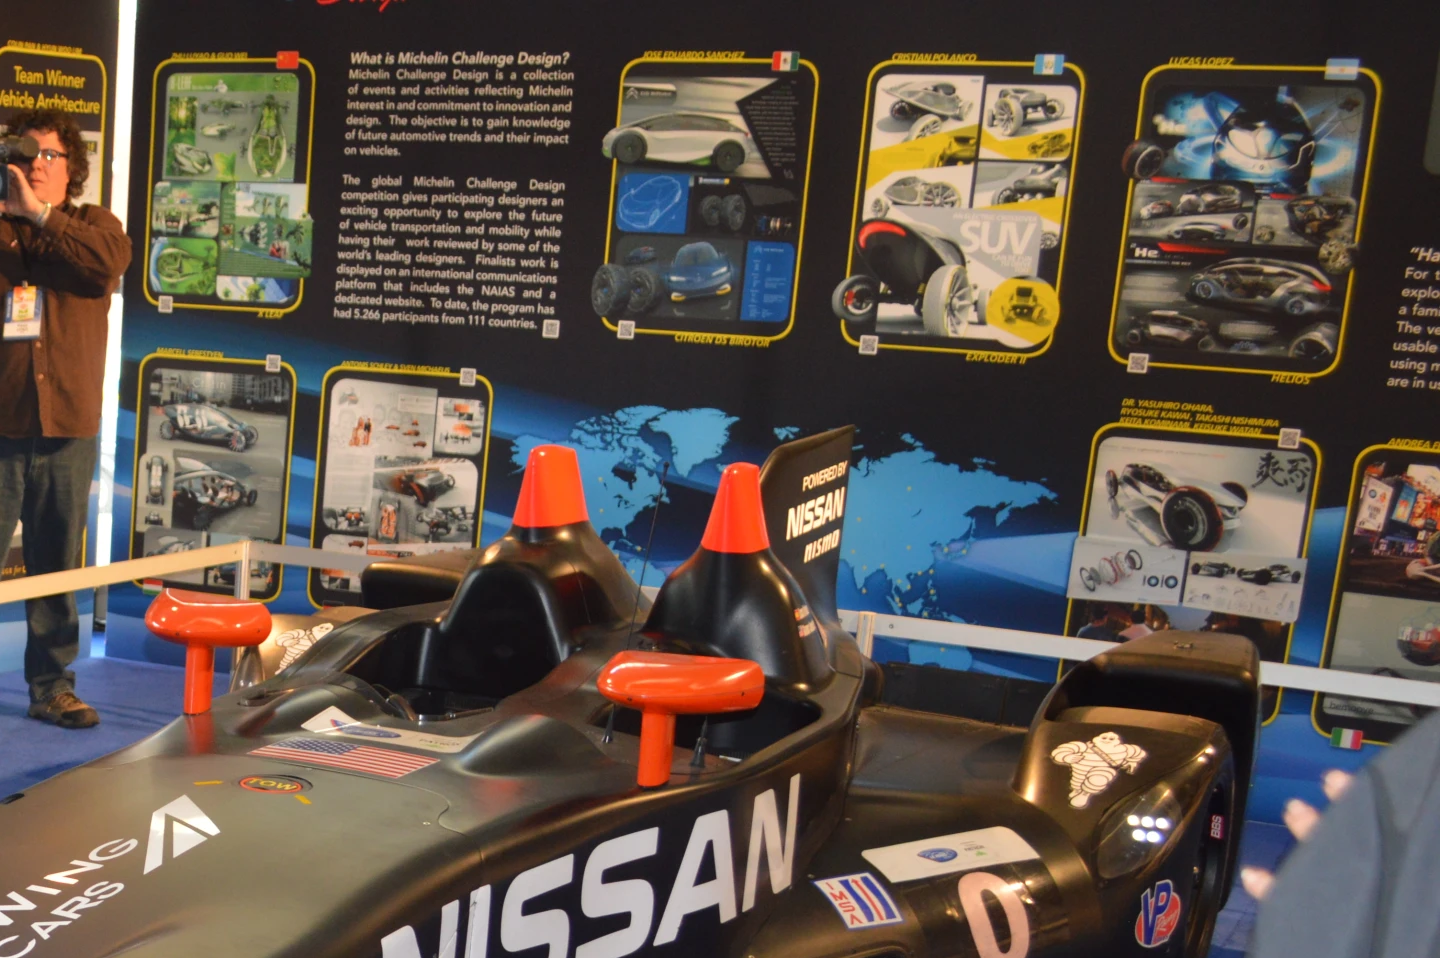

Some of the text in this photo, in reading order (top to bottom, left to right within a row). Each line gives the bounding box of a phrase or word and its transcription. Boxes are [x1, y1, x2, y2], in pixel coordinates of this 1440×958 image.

[350, 51, 570, 67] What is Michelin Challenge Design?
[14, 65, 85, 90] Team Winner
[348, 68, 390, 79] Michelin
[395, 69, 446, 82] Challenge
[452, 69, 488, 82] Design
[495, 69, 503, 79] is
[522, 69, 574, 80] collection
[347, 83, 573, 98] of events and activities reflecting Michelin
[36, 92, 100, 115] Architecture
[346, 99, 572, 112] interest in and commitment to innovation and
[345, 114, 570, 130] design. The objective is to gain knowledge
[344, 129, 568, 146] of future automotive trends and their impact
[359, 144, 400, 155] vehicles.
[342, 174, 565, 193] The global Michelin Challenge Design
[960, 220, 1036, 255] SUV
[1404, 267, 1428, 279] For
[1398, 305, 1407, 315] a
[333, 307, 351, 318] had
[382, 310, 439, 325] participants
[441, 312, 464, 324] from
[468, 314, 484, 325] 111
[488, 316, 538, 329] countries.
[1396, 321, 1422, 335] The
[1393, 341, 1438, 353] usable
[965, 352, 1017, 364] EXPLODER
[1390, 358, 1427, 373] using
[1270, 374, 1310, 385] HELIOS
[1387, 376, 1425, 389] are in
[802, 460, 849, 493] POWERED BY
[786, 486, 845, 541] NISSAN
[249, 778, 297, 790] TOW
[1210, 815, 1222, 839] BBS
[824, 882, 862, 924] IMSA
[1141, 880, 1173, 946] VP
